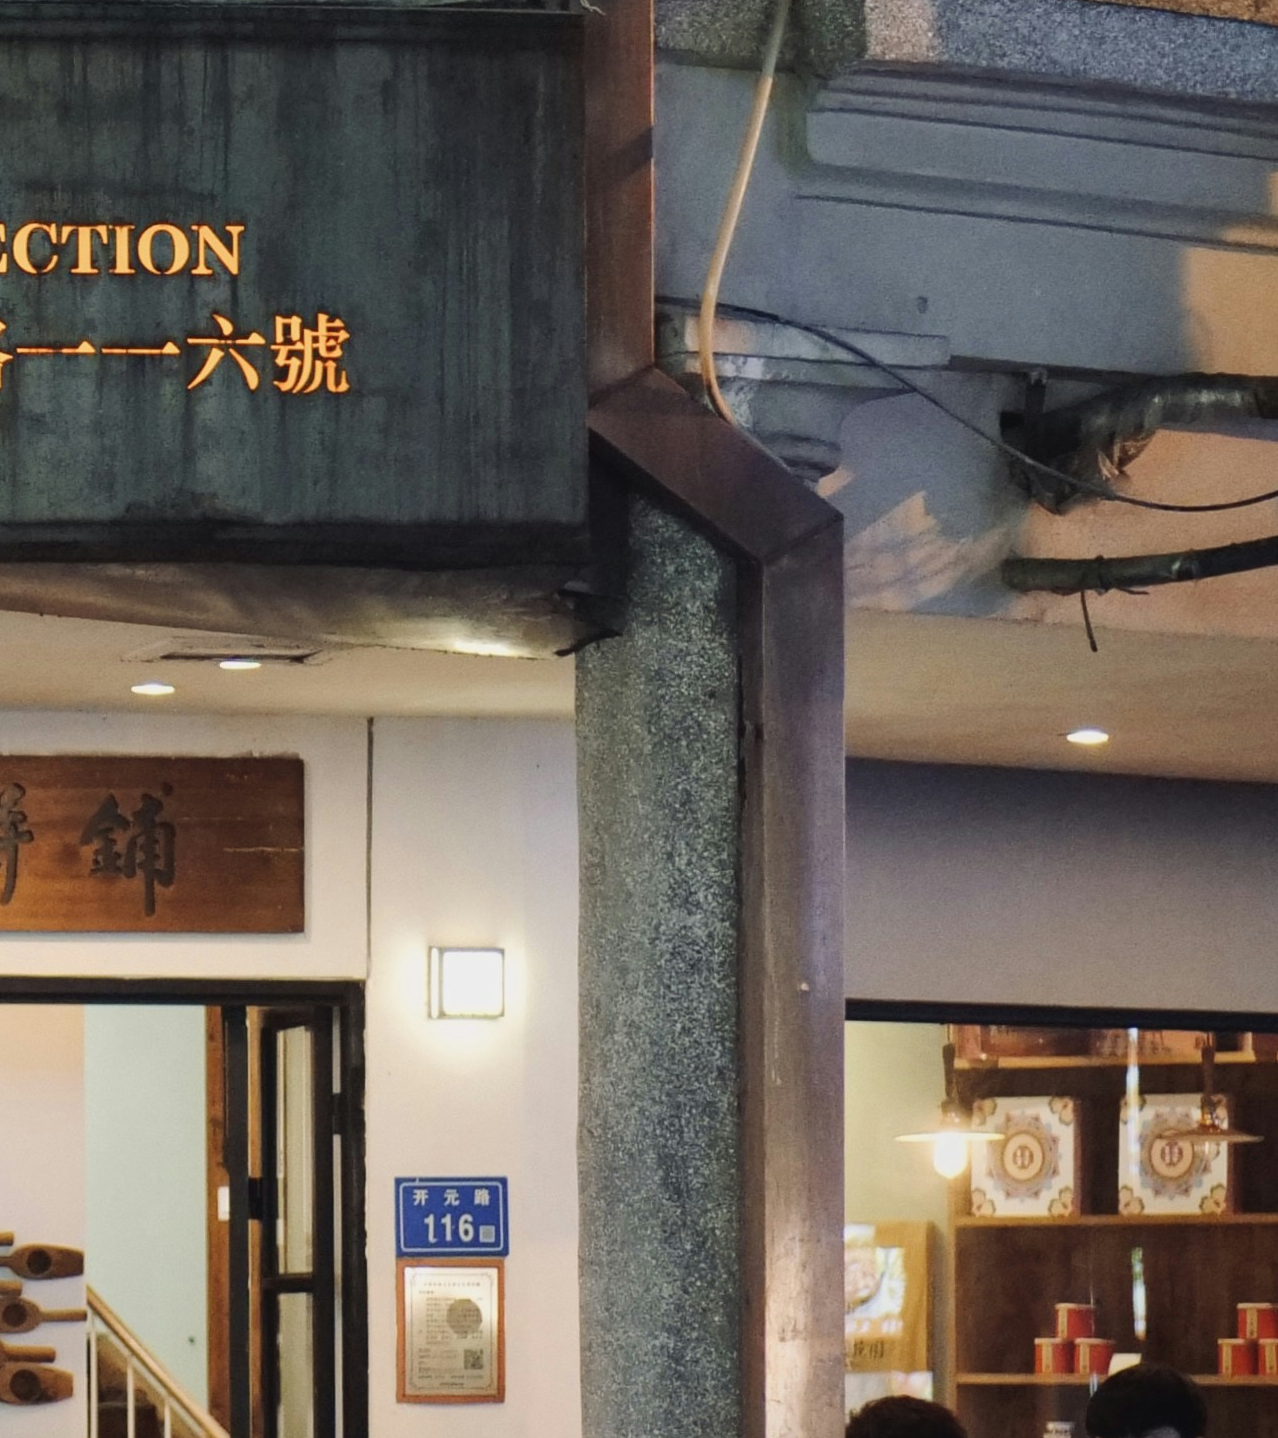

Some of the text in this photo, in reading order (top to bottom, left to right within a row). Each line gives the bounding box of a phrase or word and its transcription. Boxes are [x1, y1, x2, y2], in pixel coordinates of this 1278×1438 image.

[413, 1189, 490, 1206] 开元路
[424, 1214, 474, 1243] 116
